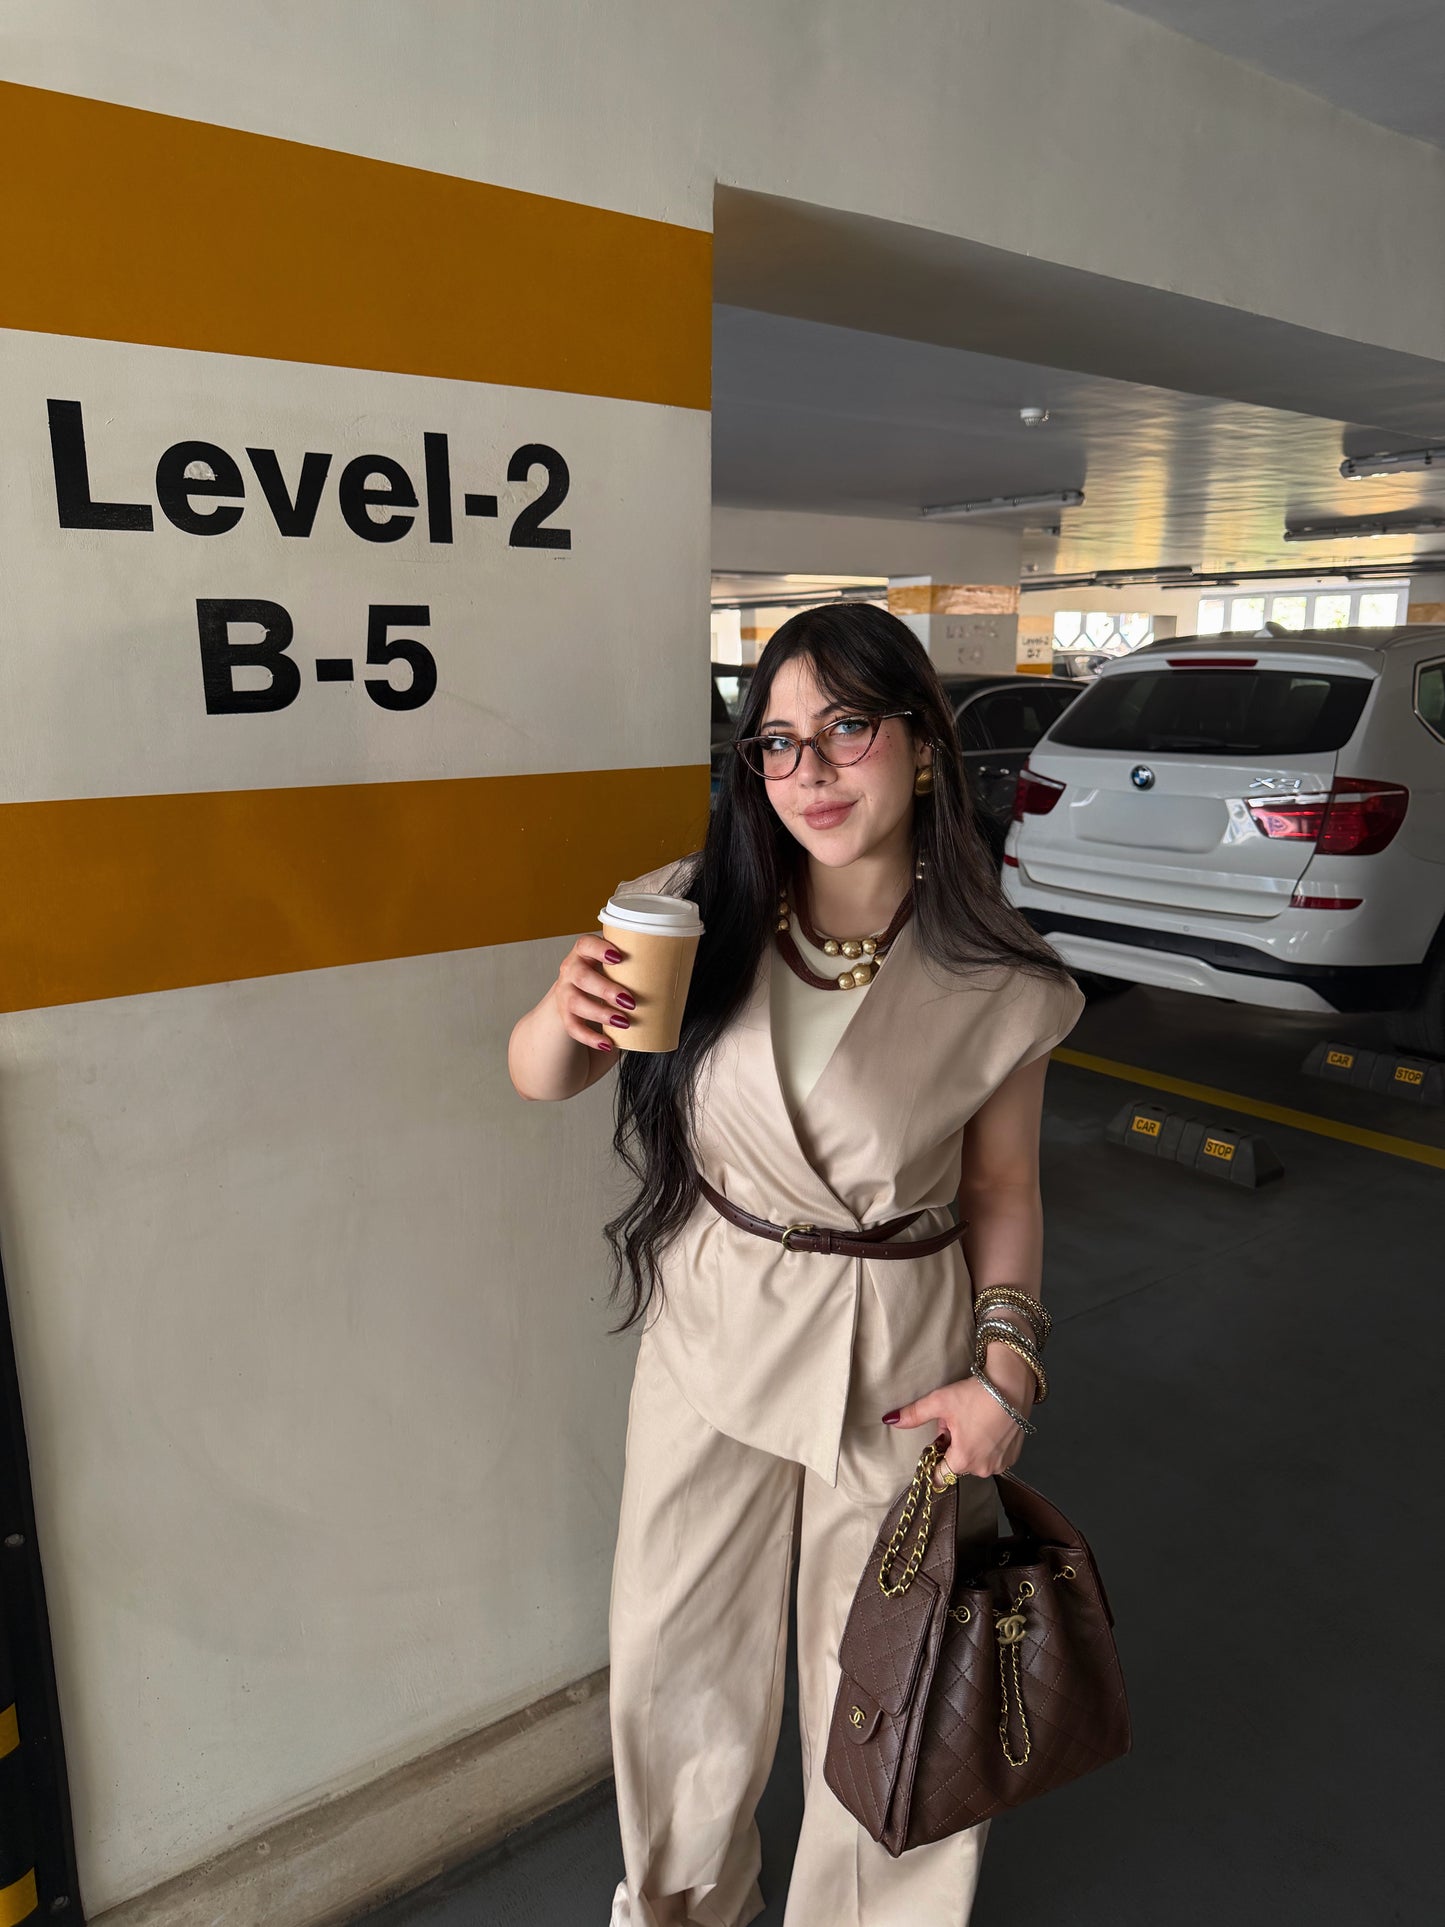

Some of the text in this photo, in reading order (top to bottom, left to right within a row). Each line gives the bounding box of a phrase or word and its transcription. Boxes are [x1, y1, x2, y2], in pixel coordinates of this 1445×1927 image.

[47, 398, 572, 551] Level-2
[196, 598, 438, 715] B-5
[1330, 1053, 1422, 1083] CAR STOP
[1136, 1119, 1233, 1158] CAR STOP
